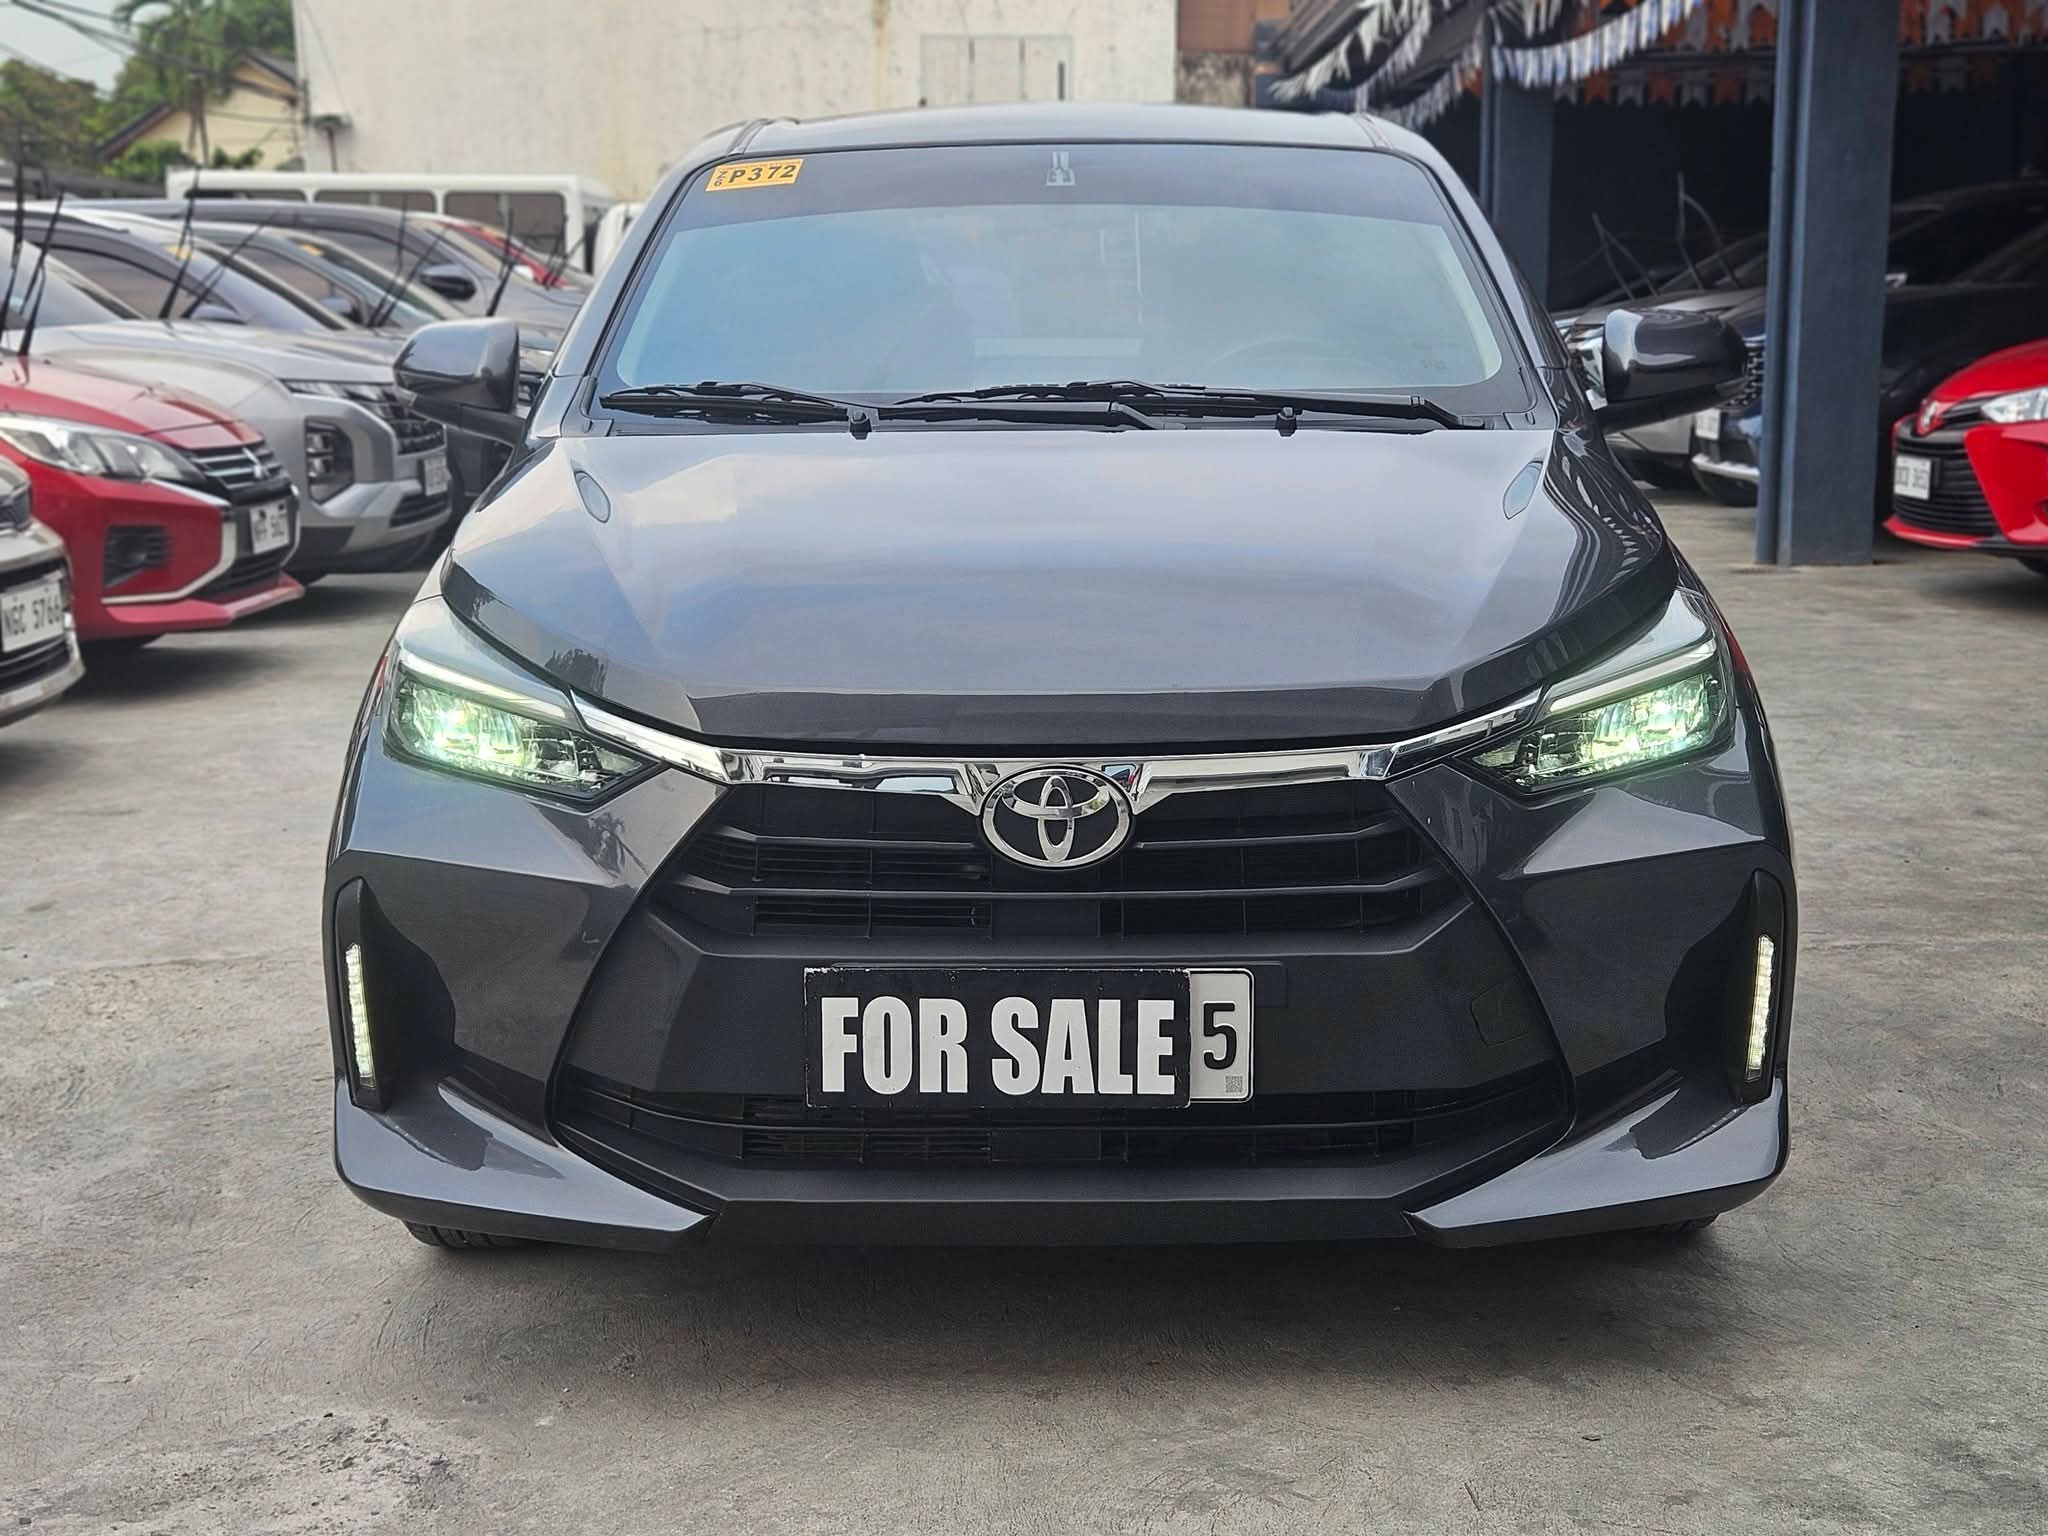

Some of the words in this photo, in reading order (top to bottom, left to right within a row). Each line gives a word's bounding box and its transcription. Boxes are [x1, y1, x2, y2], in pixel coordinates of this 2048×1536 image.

[728, 164, 797, 184] P372
[821, 995, 969, 1095] FOR
[990, 996, 1175, 1096] SALE
[1203, 1001, 1238, 1070] 5
